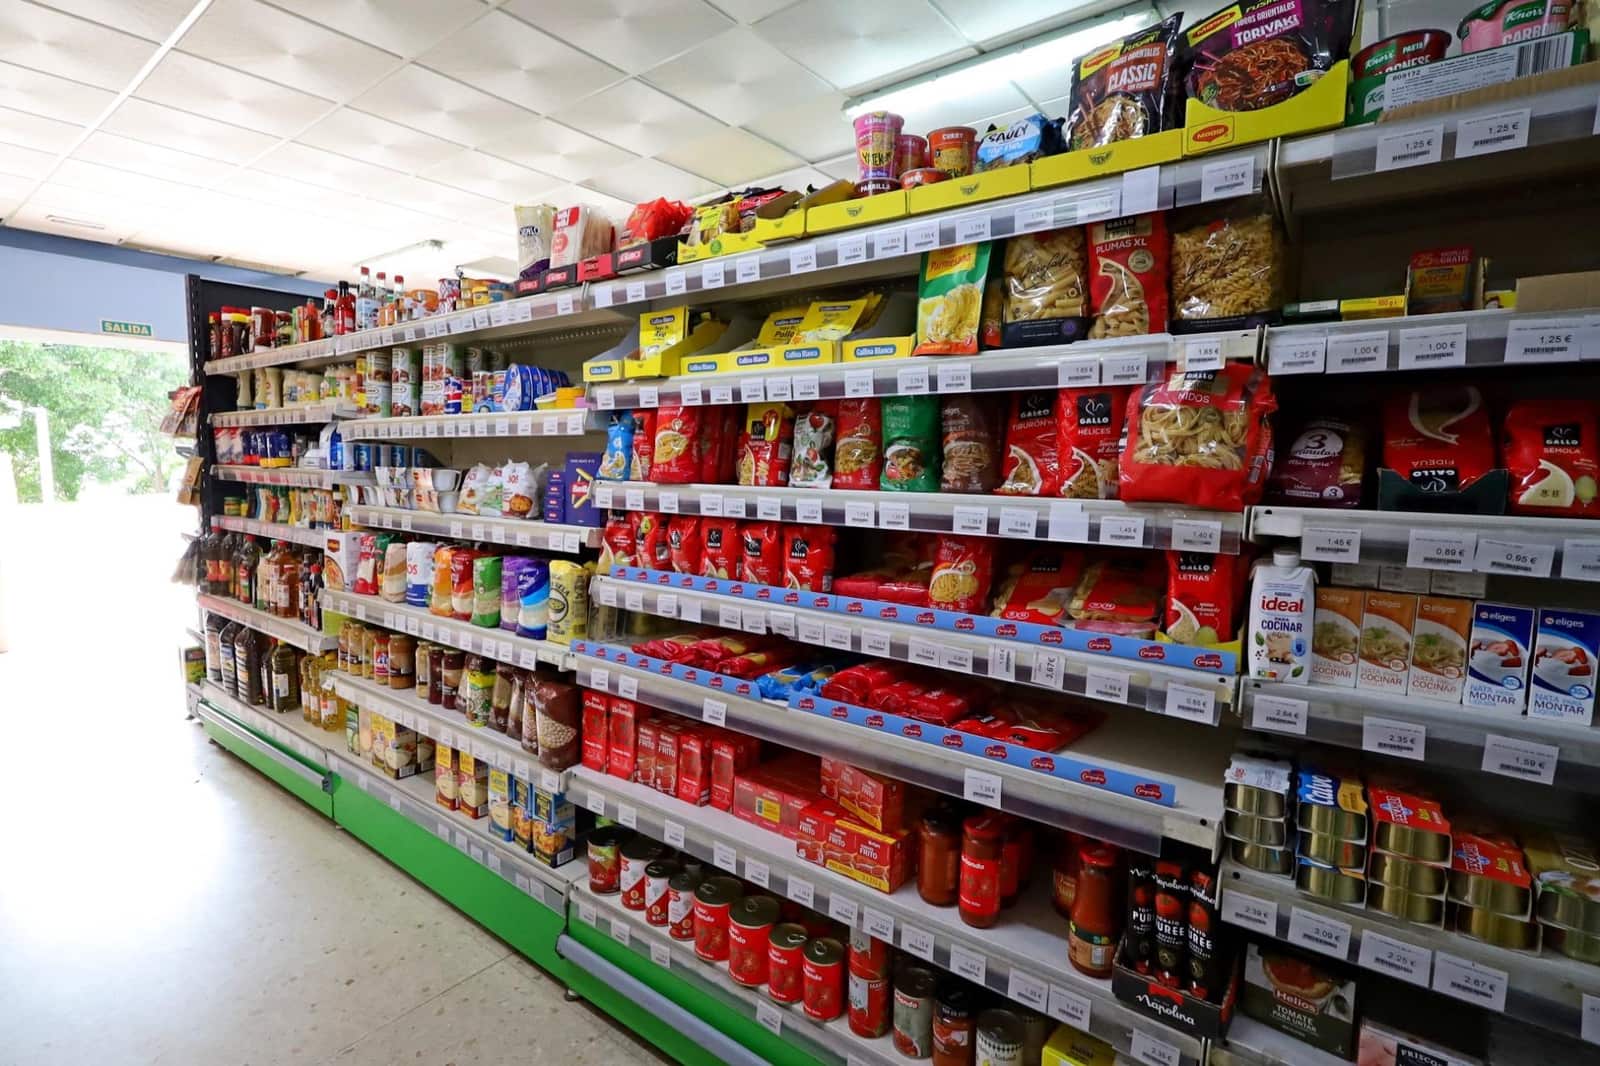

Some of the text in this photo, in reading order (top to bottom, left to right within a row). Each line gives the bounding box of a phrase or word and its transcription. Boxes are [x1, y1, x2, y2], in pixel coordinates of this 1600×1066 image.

[1506, 5, 1545, 22] Knorr
[1235, 14, 1300, 46] TORIYAKI
[1365, 52, 1393, 70] Knorr
[1095, 238, 1148, 254] PLUMAS XL
[103, 322, 150, 336] SALIDA
[1178, 392, 1210, 404] NIDOS
[1020, 409, 1050, 418] GALLO
[1304, 434, 1328, 449] 3
[1328, 488, 1338, 496] 3
[1178, 574, 1210, 582] LETRAS
[1262, 596, 1304, 613] ideal
[1490, 614, 1516, 622] eliges
[1556, 618, 1584, 628] eliges
[1262, 620, 1303, 632] COCINAR
[1312, 667, 1352, 678] COCINAR
[1360, 673, 1402, 686] COCINAR
[1412, 680, 1456, 693] COCINAR
[1470, 691, 1516, 705] MONTAR
[1534, 700, 1585, 715] MONTAR
[1190, 886, 1216, 904] apolina
[1156, 920, 1185, 936] UREE
[1188, 930, 1213, 950] UREE
[1276, 990, 1317, 1012] Helios
[1136, 994, 1196, 1026] Napolina
[1276, 1004, 1313, 1024] TOMATE
